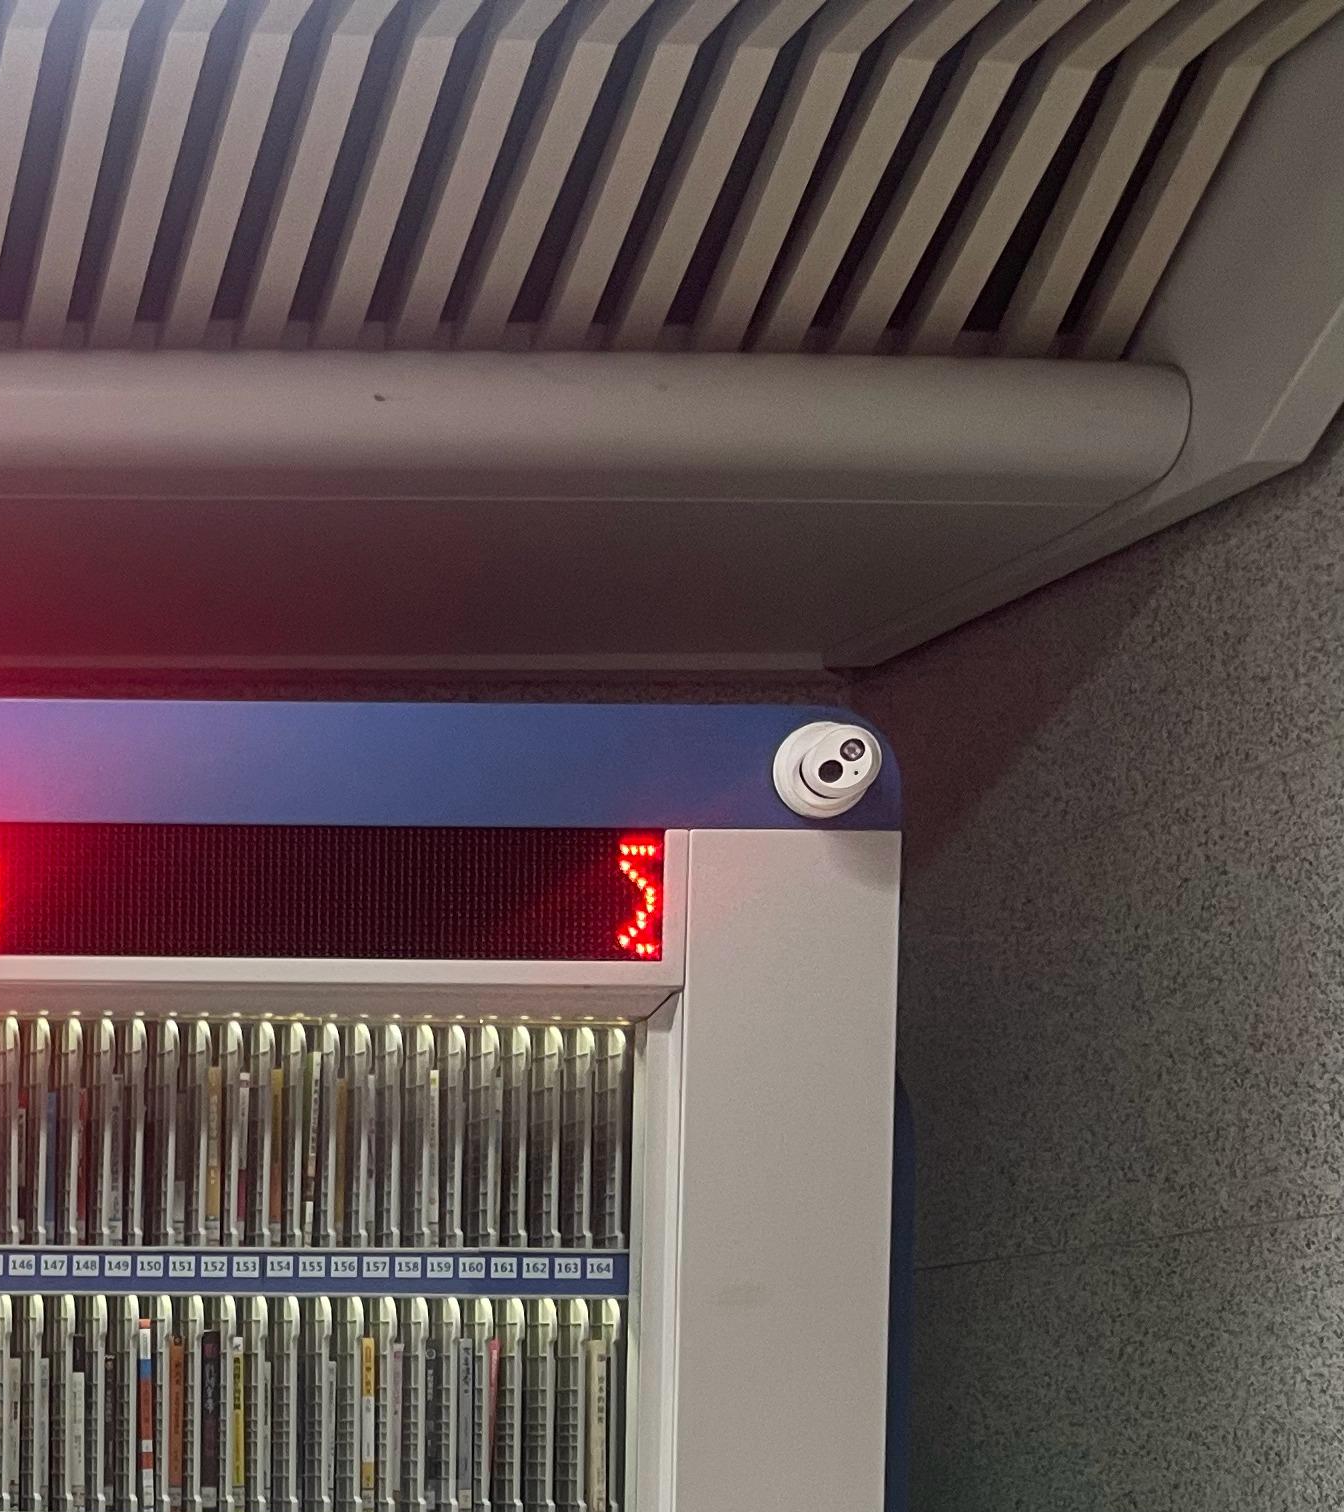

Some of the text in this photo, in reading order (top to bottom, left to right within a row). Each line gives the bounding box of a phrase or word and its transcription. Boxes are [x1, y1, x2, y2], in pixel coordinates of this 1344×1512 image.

[12, 1260, 32, 1270] 146
[172, 1261, 192, 1271] 151
[334, 1261, 355, 1272] 156
[494, 1262, 514, 1273] 161
[589, 1263, 610, 1273] 164
